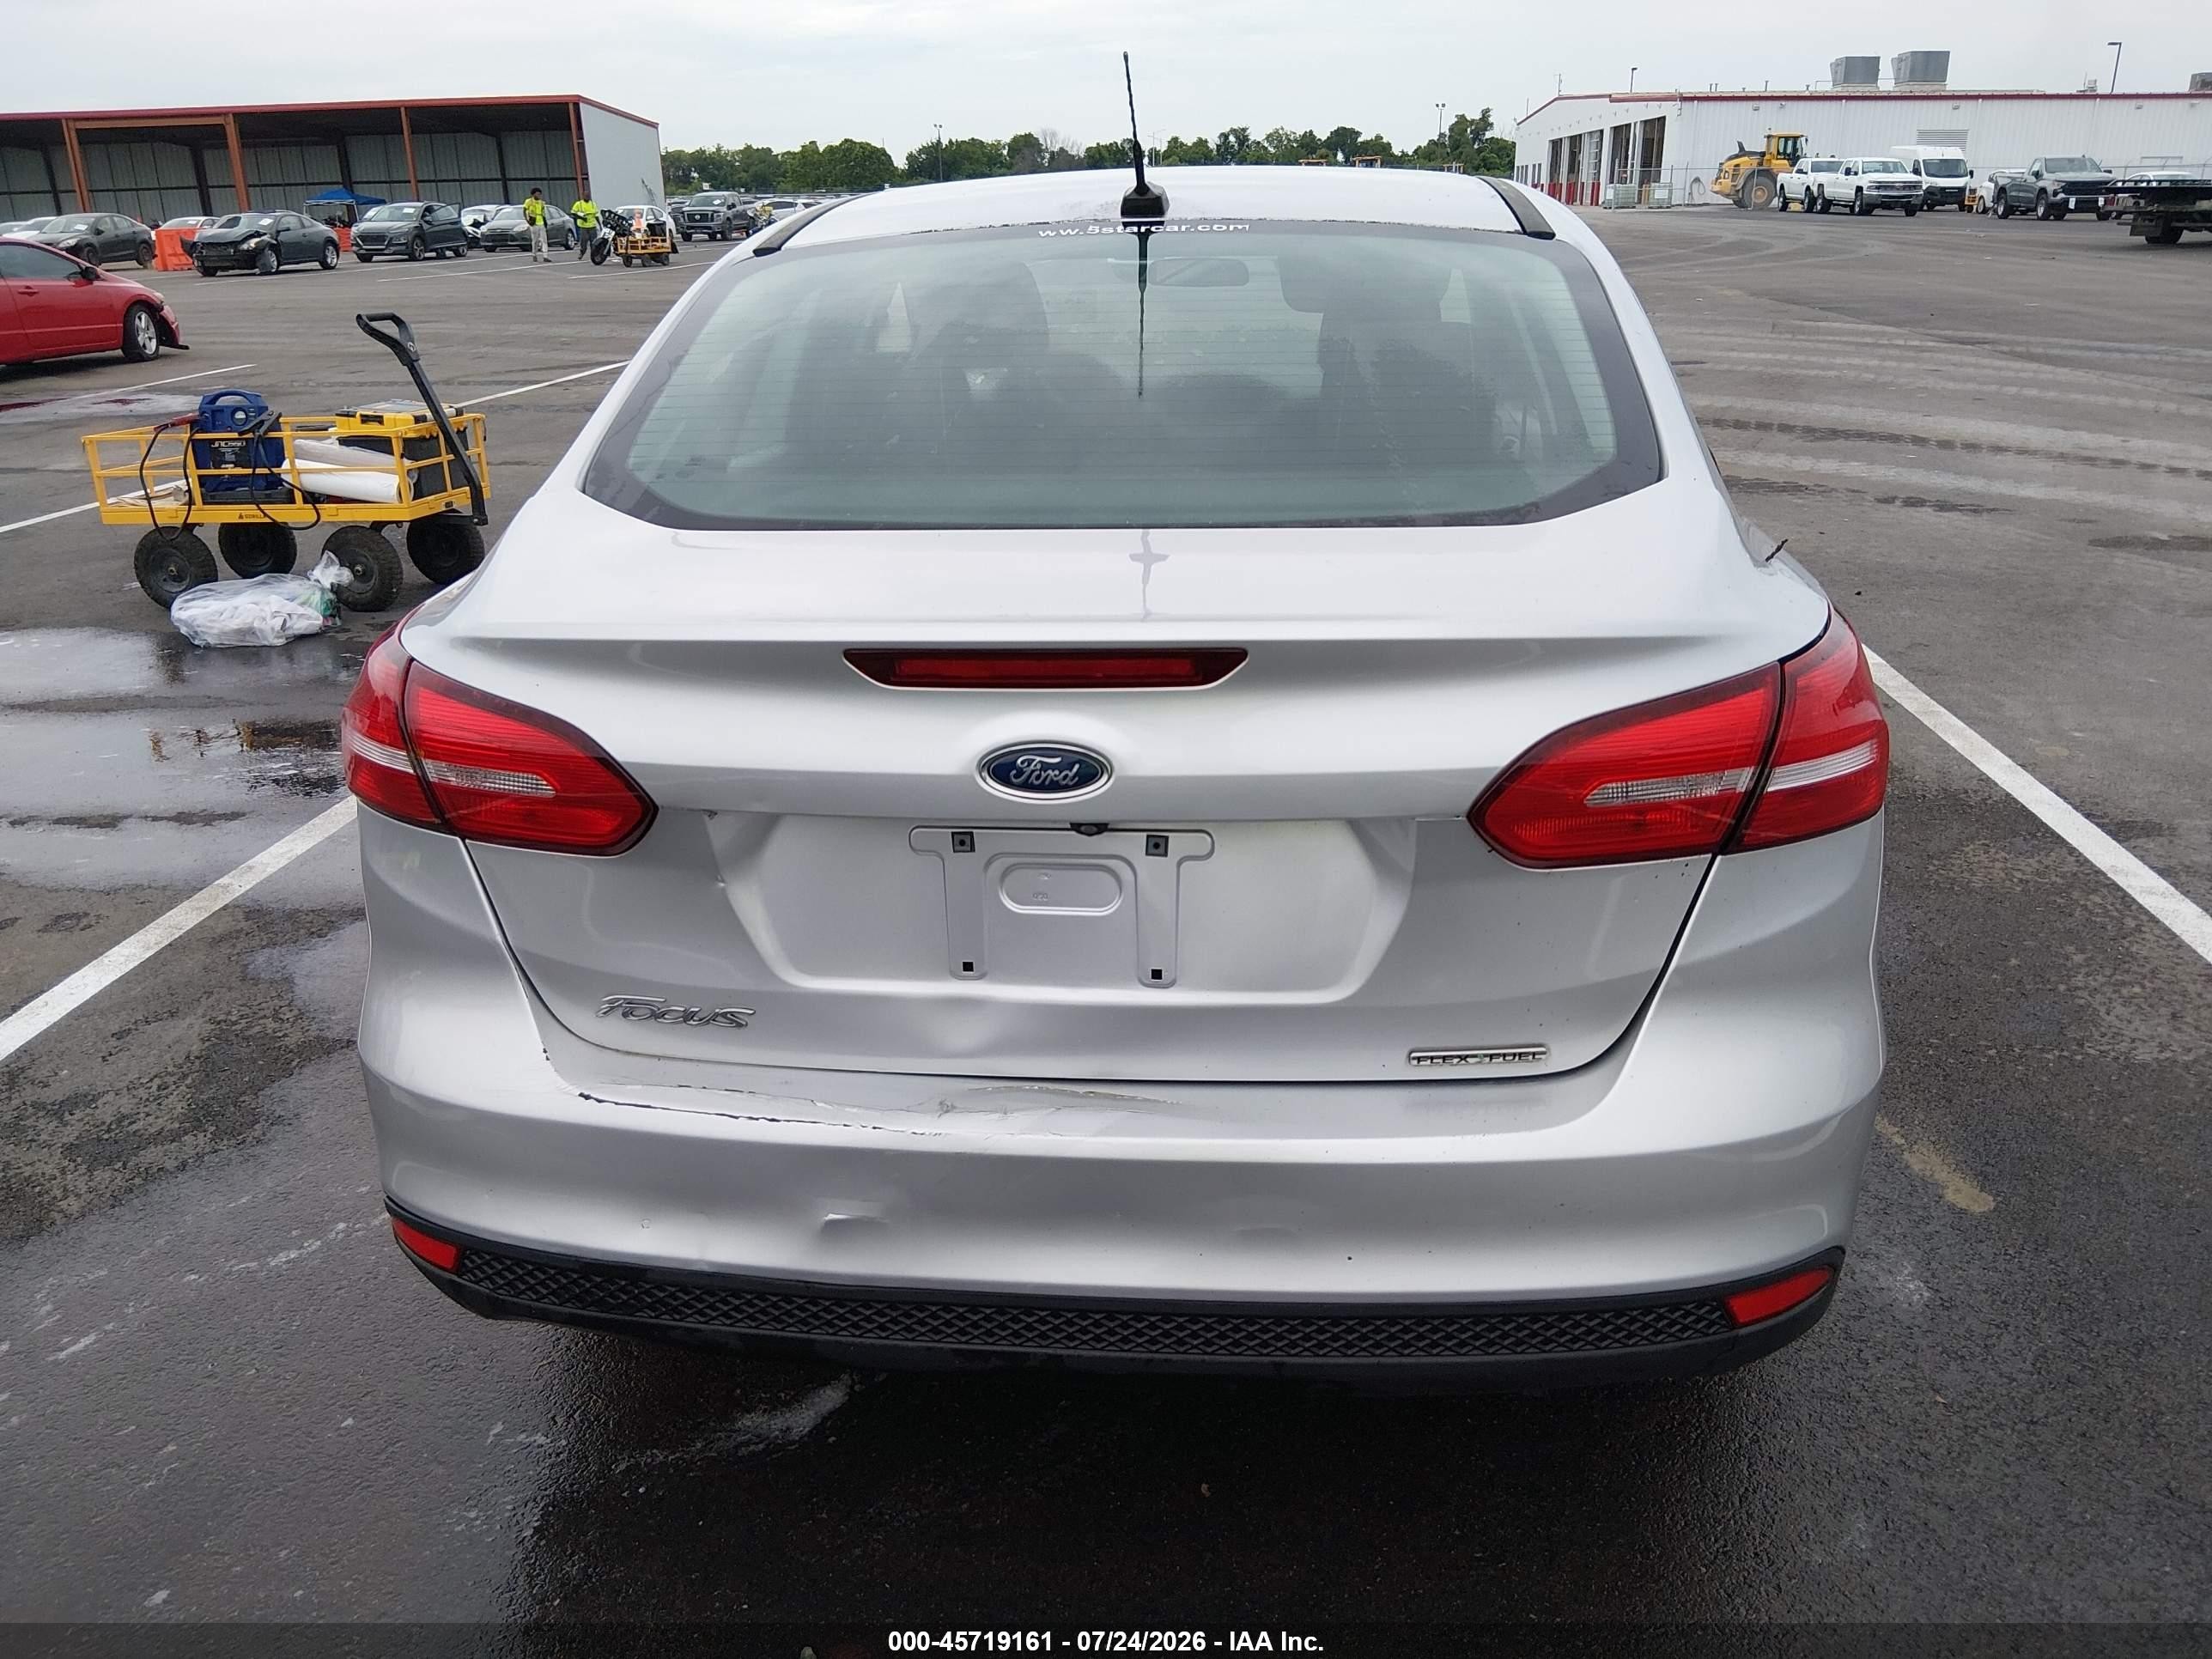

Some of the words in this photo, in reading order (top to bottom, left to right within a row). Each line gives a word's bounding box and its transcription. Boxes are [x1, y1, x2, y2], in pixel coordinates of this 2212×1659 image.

[1009, 755, 1080, 786] Ford
[1417, 1054, 1469, 1065] FLEX
[1489, 1051, 1543, 1062] FUEL
